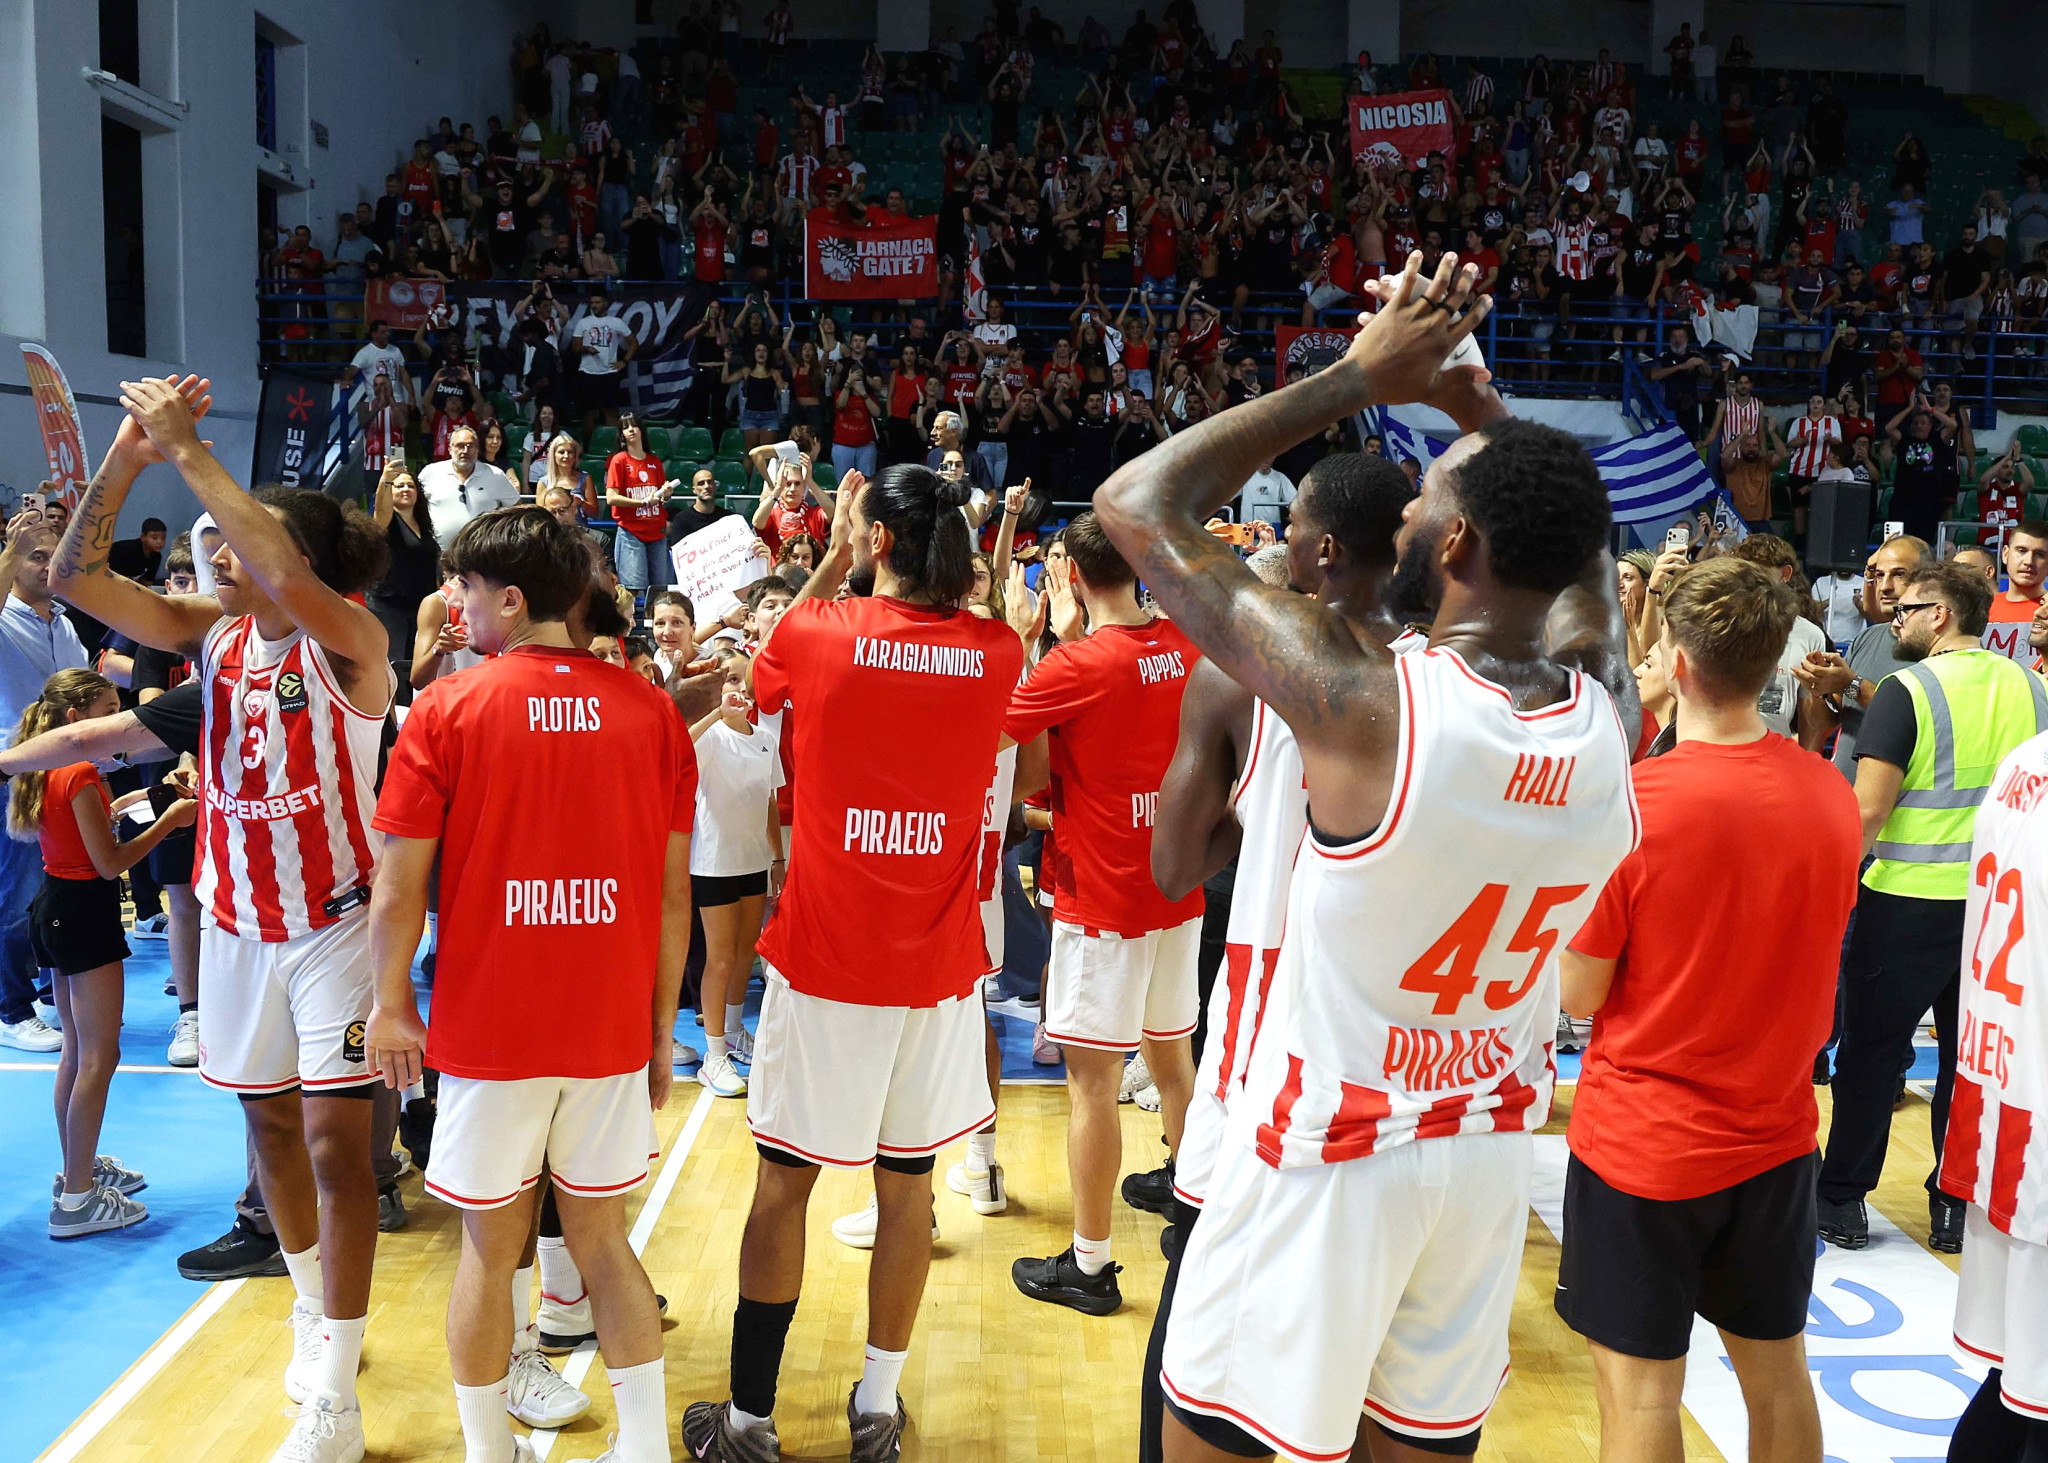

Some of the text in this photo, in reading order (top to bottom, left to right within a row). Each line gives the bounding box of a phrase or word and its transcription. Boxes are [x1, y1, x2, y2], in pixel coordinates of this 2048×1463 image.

[1359, 100, 1448, 131] NICOSIA
[856, 237, 934, 257] LARNACA
[863, 255, 925, 276] GATE 7
[1288, 331, 1321, 362] PAFOS
[437, 383, 464, 396] bwin
[675, 532, 732, 569] Fournier
[721, 561, 742, 574] avoir
[853, 635, 985, 679] KARAGIANNIDIS
[1137, 650, 1186, 685] PAPPAS
[281, 701, 306, 710] ETIHAD
[527, 696, 601, 732] PLOTAS
[242, 725, 266, 770] 3
[1503, 752, 1576, 807] HALL
[206, 783, 321, 821] SUPERBET
[844, 807, 946, 855] PIRAEUS
[505, 878, 618, 926] PIRAEUS
[1972, 851, 2024, 1006] 22
[1398, 882, 1590, 1015] 45
[1383, 1025, 1514, 1092] PIRAEUS
